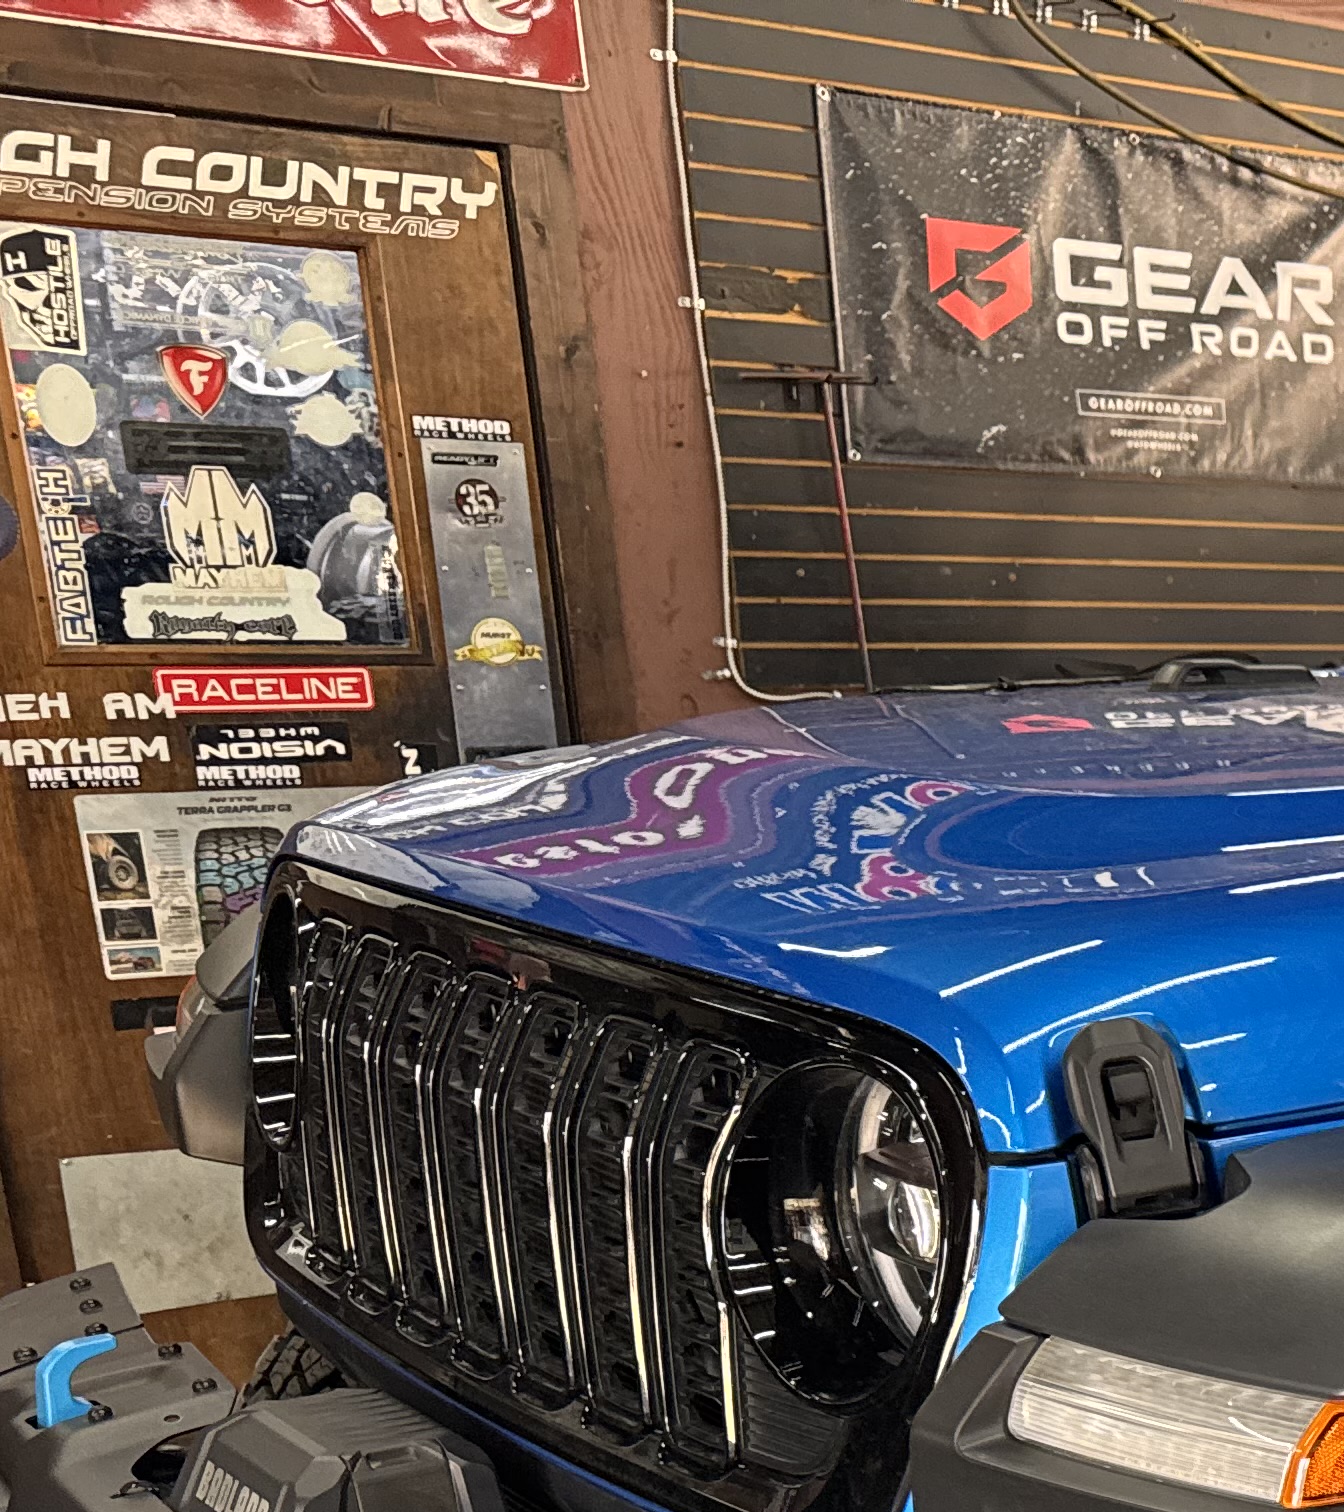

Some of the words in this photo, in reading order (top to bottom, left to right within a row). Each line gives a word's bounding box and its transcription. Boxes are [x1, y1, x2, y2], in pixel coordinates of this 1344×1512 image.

[142, 146, 498, 219] COUNTRY
[228, 198, 460, 239] SYSTEMS
[44, 237, 71, 344] HOSTILE
[1052, 237, 1335, 326] GEAR
[1057, 312, 1167, 350] OFF
[1191, 321, 1335, 365] ROAD
[1088, 396, 1213, 417] GEAROFFROAD.COM
[412, 415, 512, 435] METHOD
[414, 429, 453, 439] RACE
[456, 431, 512, 442] WHEELS
[459, 483, 495, 516] 35
[171, 677, 361, 702] RACELINE
[0, 692, 71, 722] EH
[27, 765, 140, 782] METHOD
[29, 781, 70, 789] RACE
[78, 779, 141, 788] WHEELS
[196, 765, 300, 780] METHOD
[198, 779, 236, 788] RACE
[243, 777, 302, 787] WHEELS
[177, 806, 215, 816] TERRA
[217, 805, 276, 815] GRAPPLER
